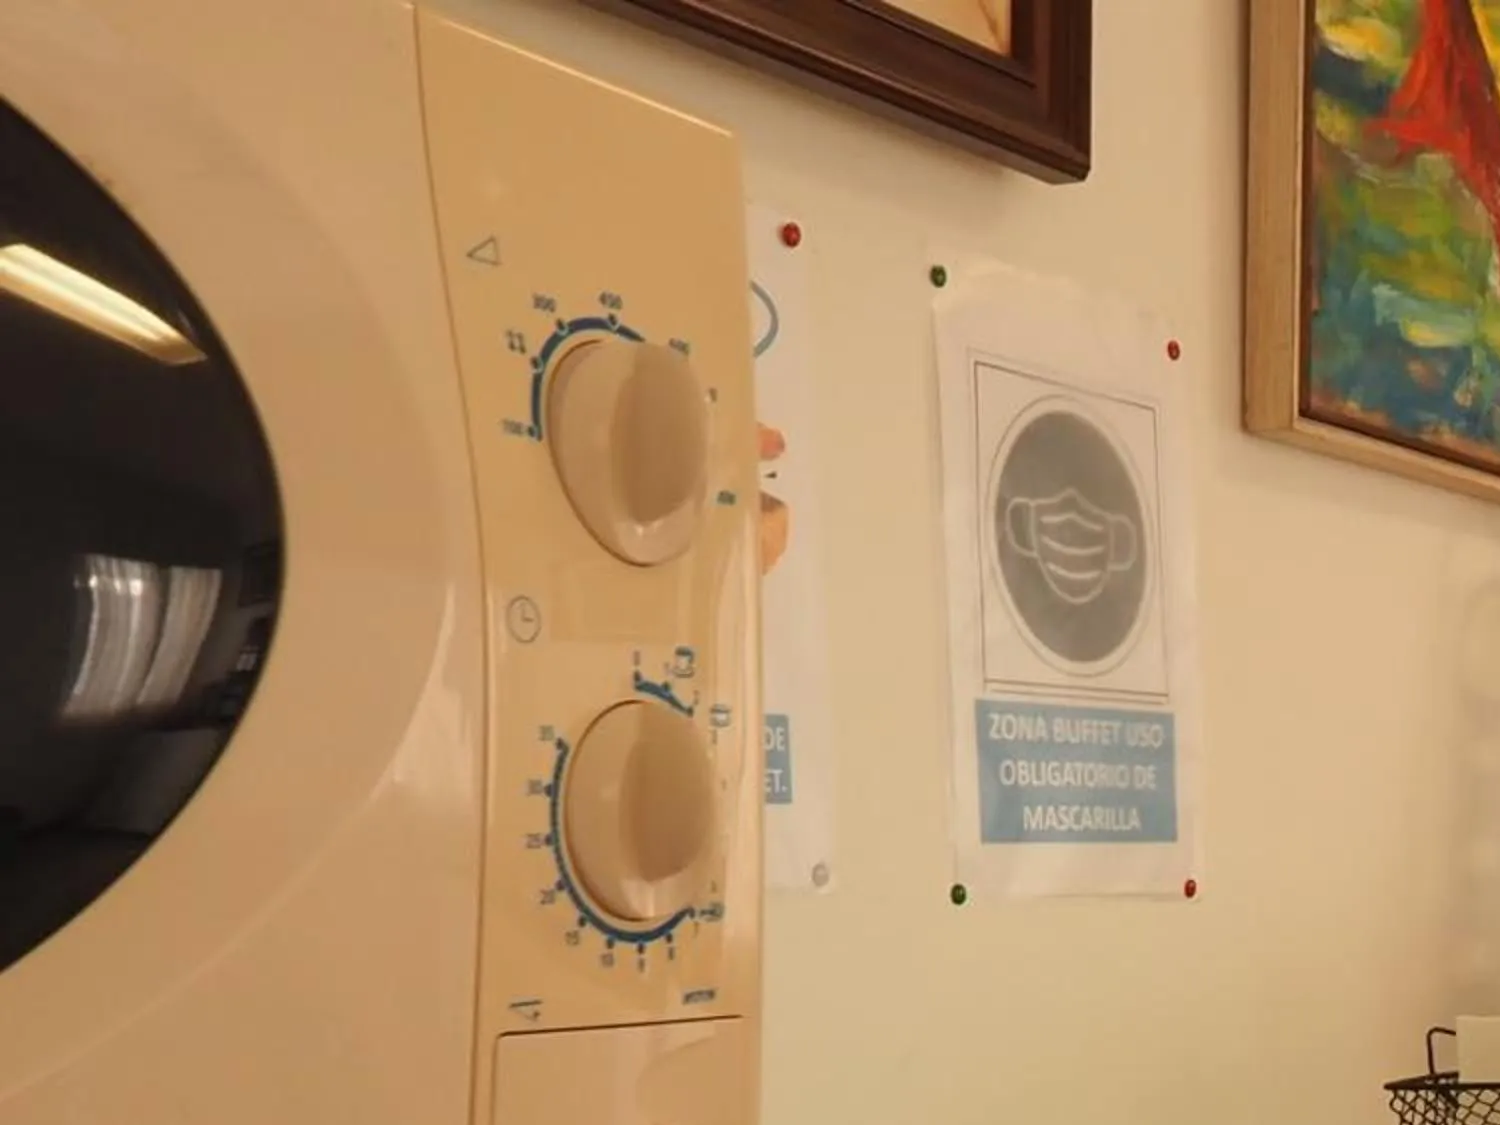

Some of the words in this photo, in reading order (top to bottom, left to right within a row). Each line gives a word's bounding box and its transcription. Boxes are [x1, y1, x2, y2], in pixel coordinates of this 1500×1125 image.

[988, 713, 1047, 742] ZONA
[1052, 717, 1121, 745] BUFFET
[1125, 722, 1165, 748] USO
[1000, 760, 1129, 788] OBLIGATORIO
[1133, 765, 1157, 789] DE
[1022, 805, 1142, 832] MASCARILLA
